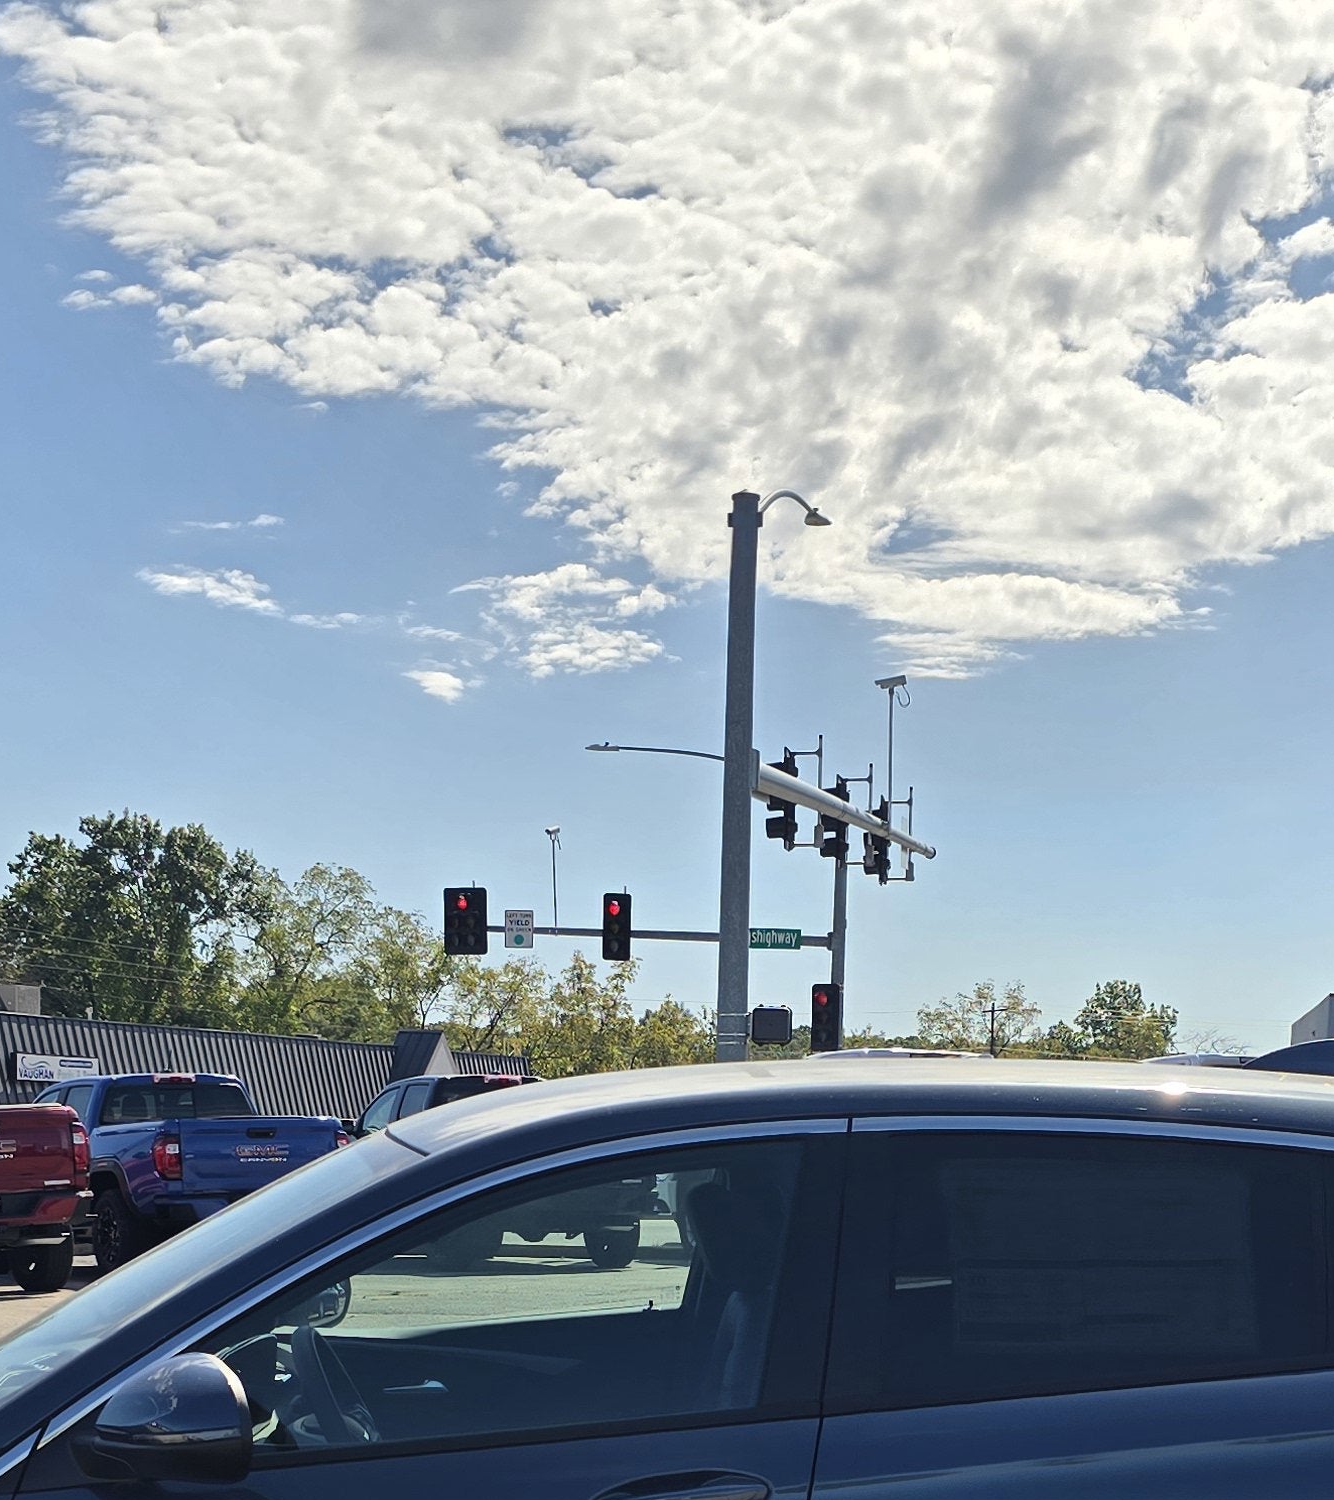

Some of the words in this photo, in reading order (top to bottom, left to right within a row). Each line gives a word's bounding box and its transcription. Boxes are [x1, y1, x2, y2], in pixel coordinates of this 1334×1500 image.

[751, 930, 797, 947] shighway
[18, 1067, 55, 1079] VAUGHAN
[236, 1144, 289, 1156] GMC
